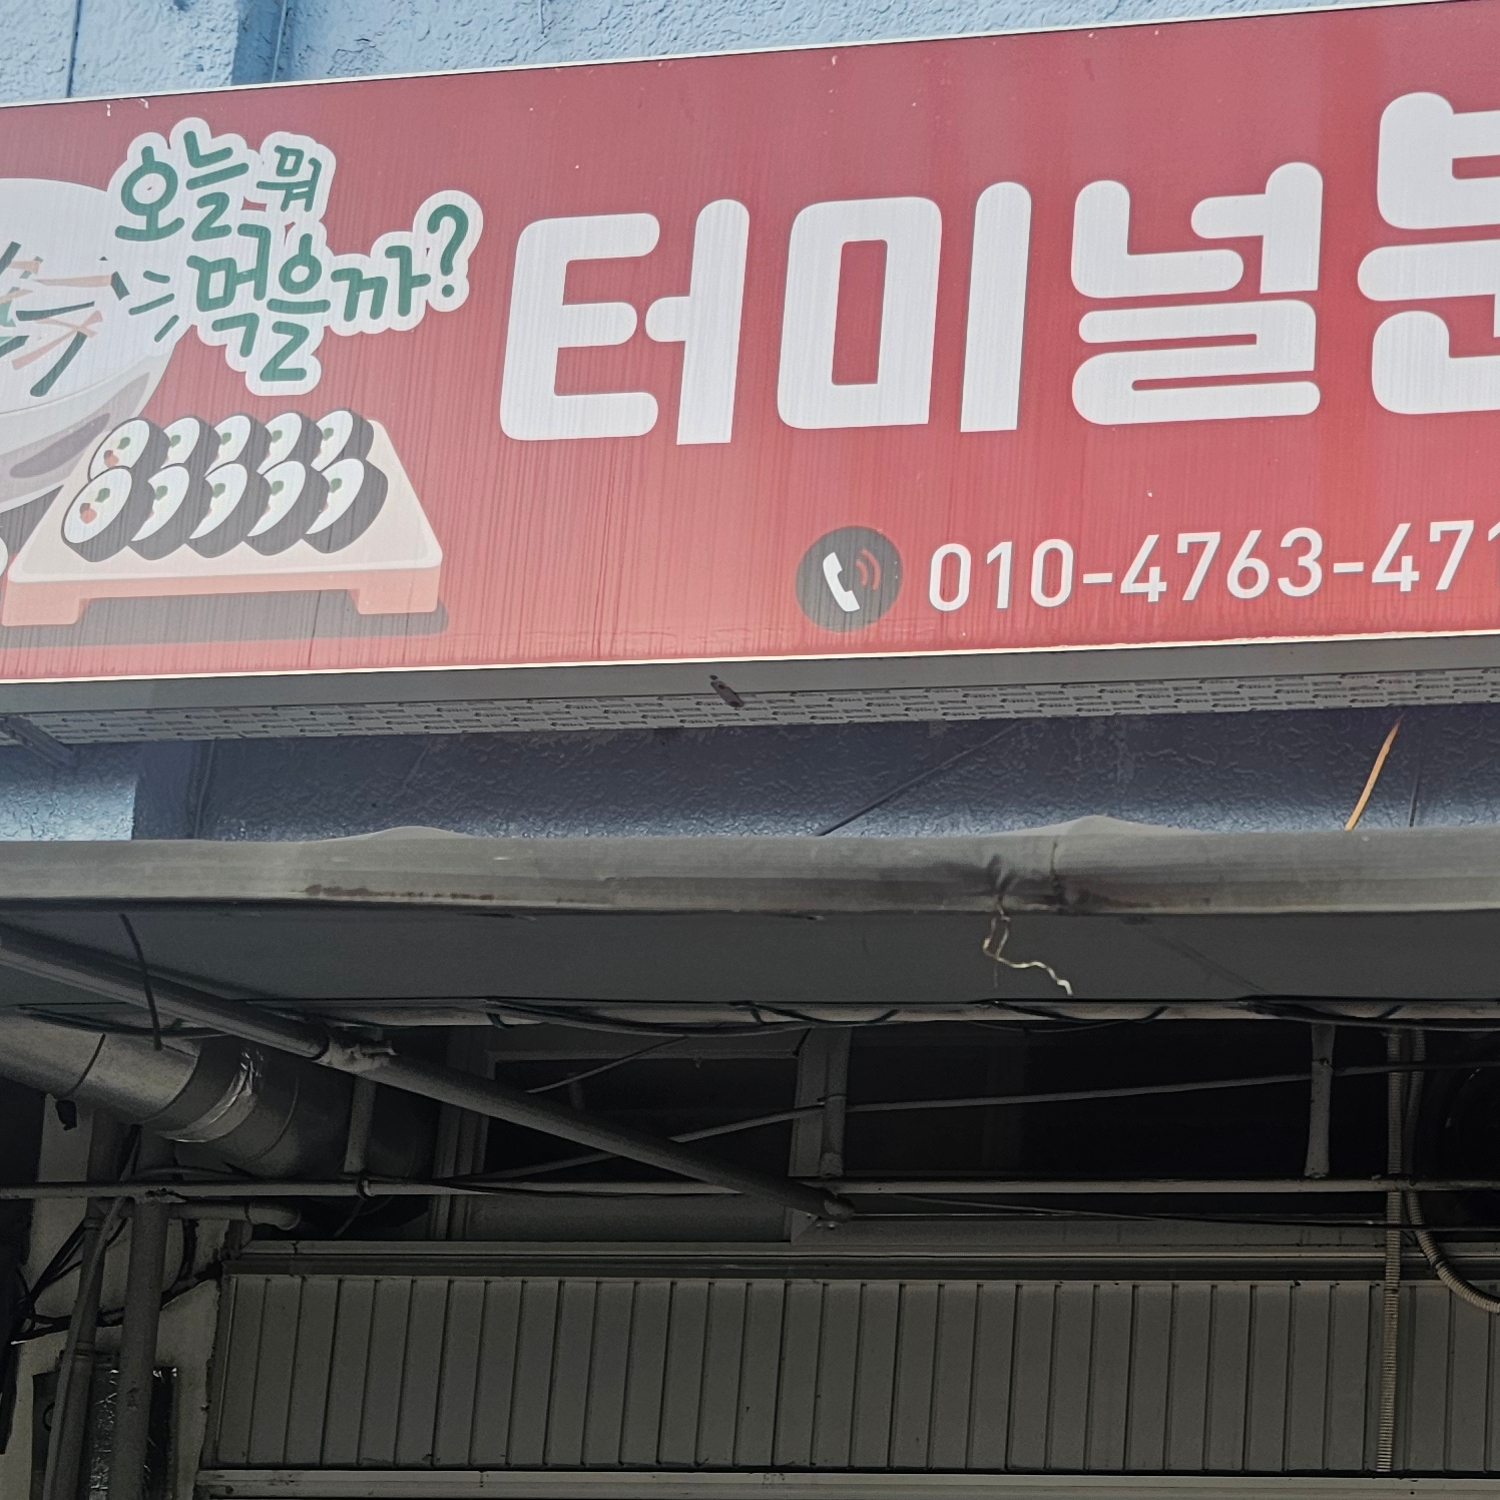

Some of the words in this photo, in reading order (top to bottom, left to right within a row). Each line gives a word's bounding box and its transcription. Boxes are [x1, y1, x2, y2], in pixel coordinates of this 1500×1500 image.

[114, 130, 250, 242] 오늘
[256, 144, 323, 213] 뭐
[186, 203, 470, 383] 먹을까?
